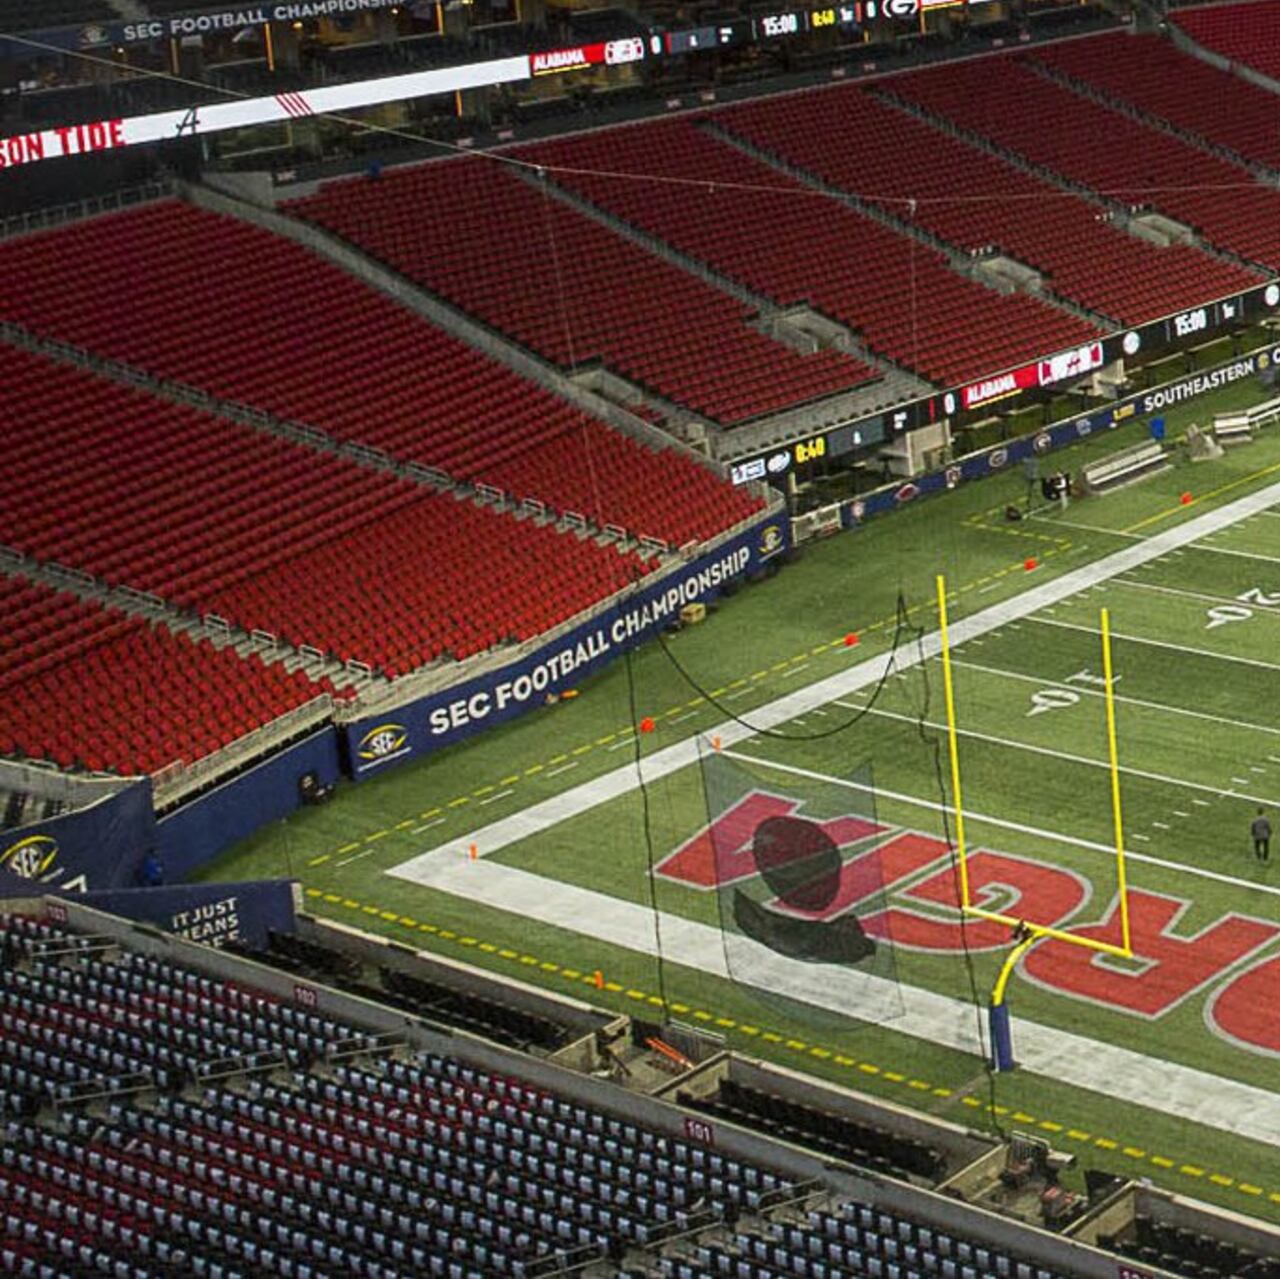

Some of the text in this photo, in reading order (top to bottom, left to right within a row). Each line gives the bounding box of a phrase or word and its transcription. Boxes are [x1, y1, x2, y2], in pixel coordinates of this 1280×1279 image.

[123, 23, 163, 42] SEC
[170, 10, 267, 35] FOOTBALL
[762, 13, 798, 37] 15:00
[533, 49, 586, 70] ALABAMA
[55, 118, 127, 156] TIDE
[1174, 308, 1207, 337] 15:00
[966, 375, 1017, 404] ALABAMA
[1144, 357, 1254, 412] SOUTHEASTERN
[429, 546, 751, 735] SEC FOOTBALL CHAMPIONSHIP
[1031, 668, 1123, 712] 10
[371, 730, 396, 753] SEC
[10, 846, 41, 878] SEC
[172, 896, 239, 928] IT JUST
